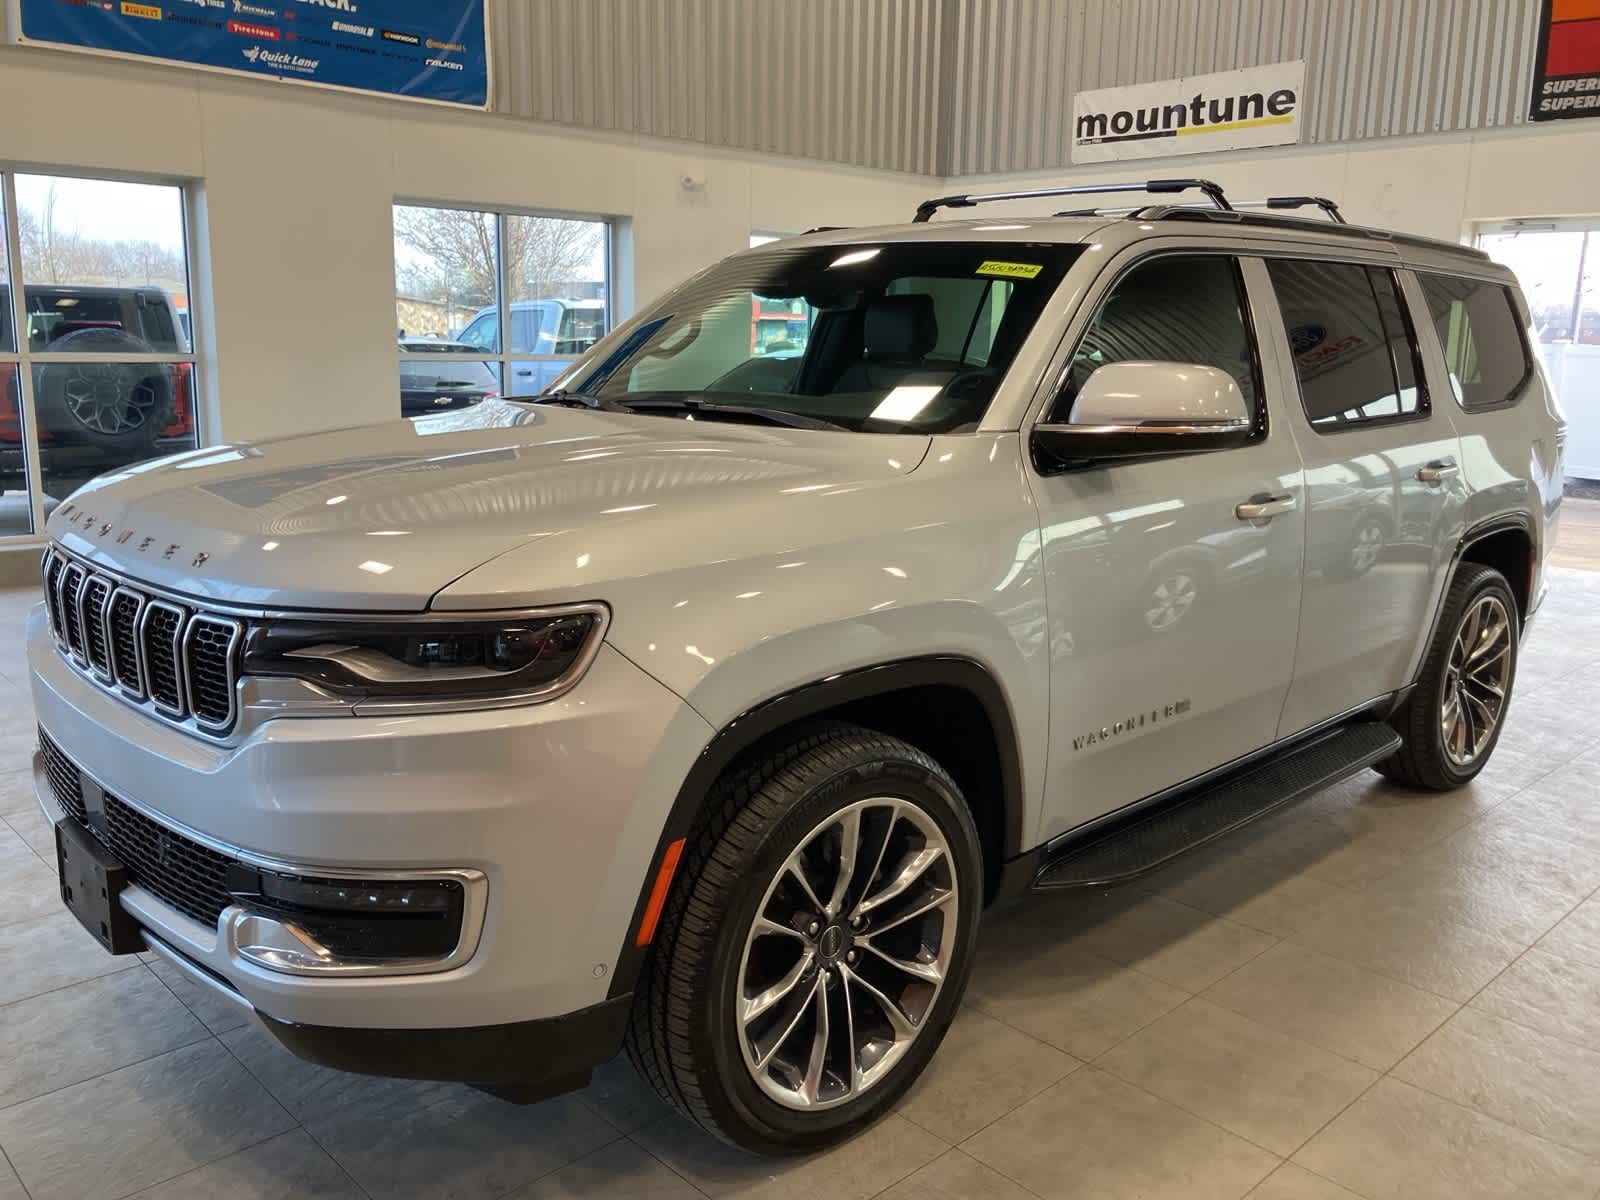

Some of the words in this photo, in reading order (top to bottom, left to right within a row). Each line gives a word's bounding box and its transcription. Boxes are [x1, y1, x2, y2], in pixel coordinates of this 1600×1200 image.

[241, 5, 276, 16] MICHELIN
[294, 0, 357, 12] ACK.
[233, 23, 275, 37] Firestone
[260, 50, 292, 64] Quick
[292, 56, 320, 68] Lane
[425, 58, 463, 71] FALKEN
[1542, 77, 1600, 94] SUPER
[1540, 95, 1600, 111] SUPER
[1076, 89, 1296, 138] mountune
